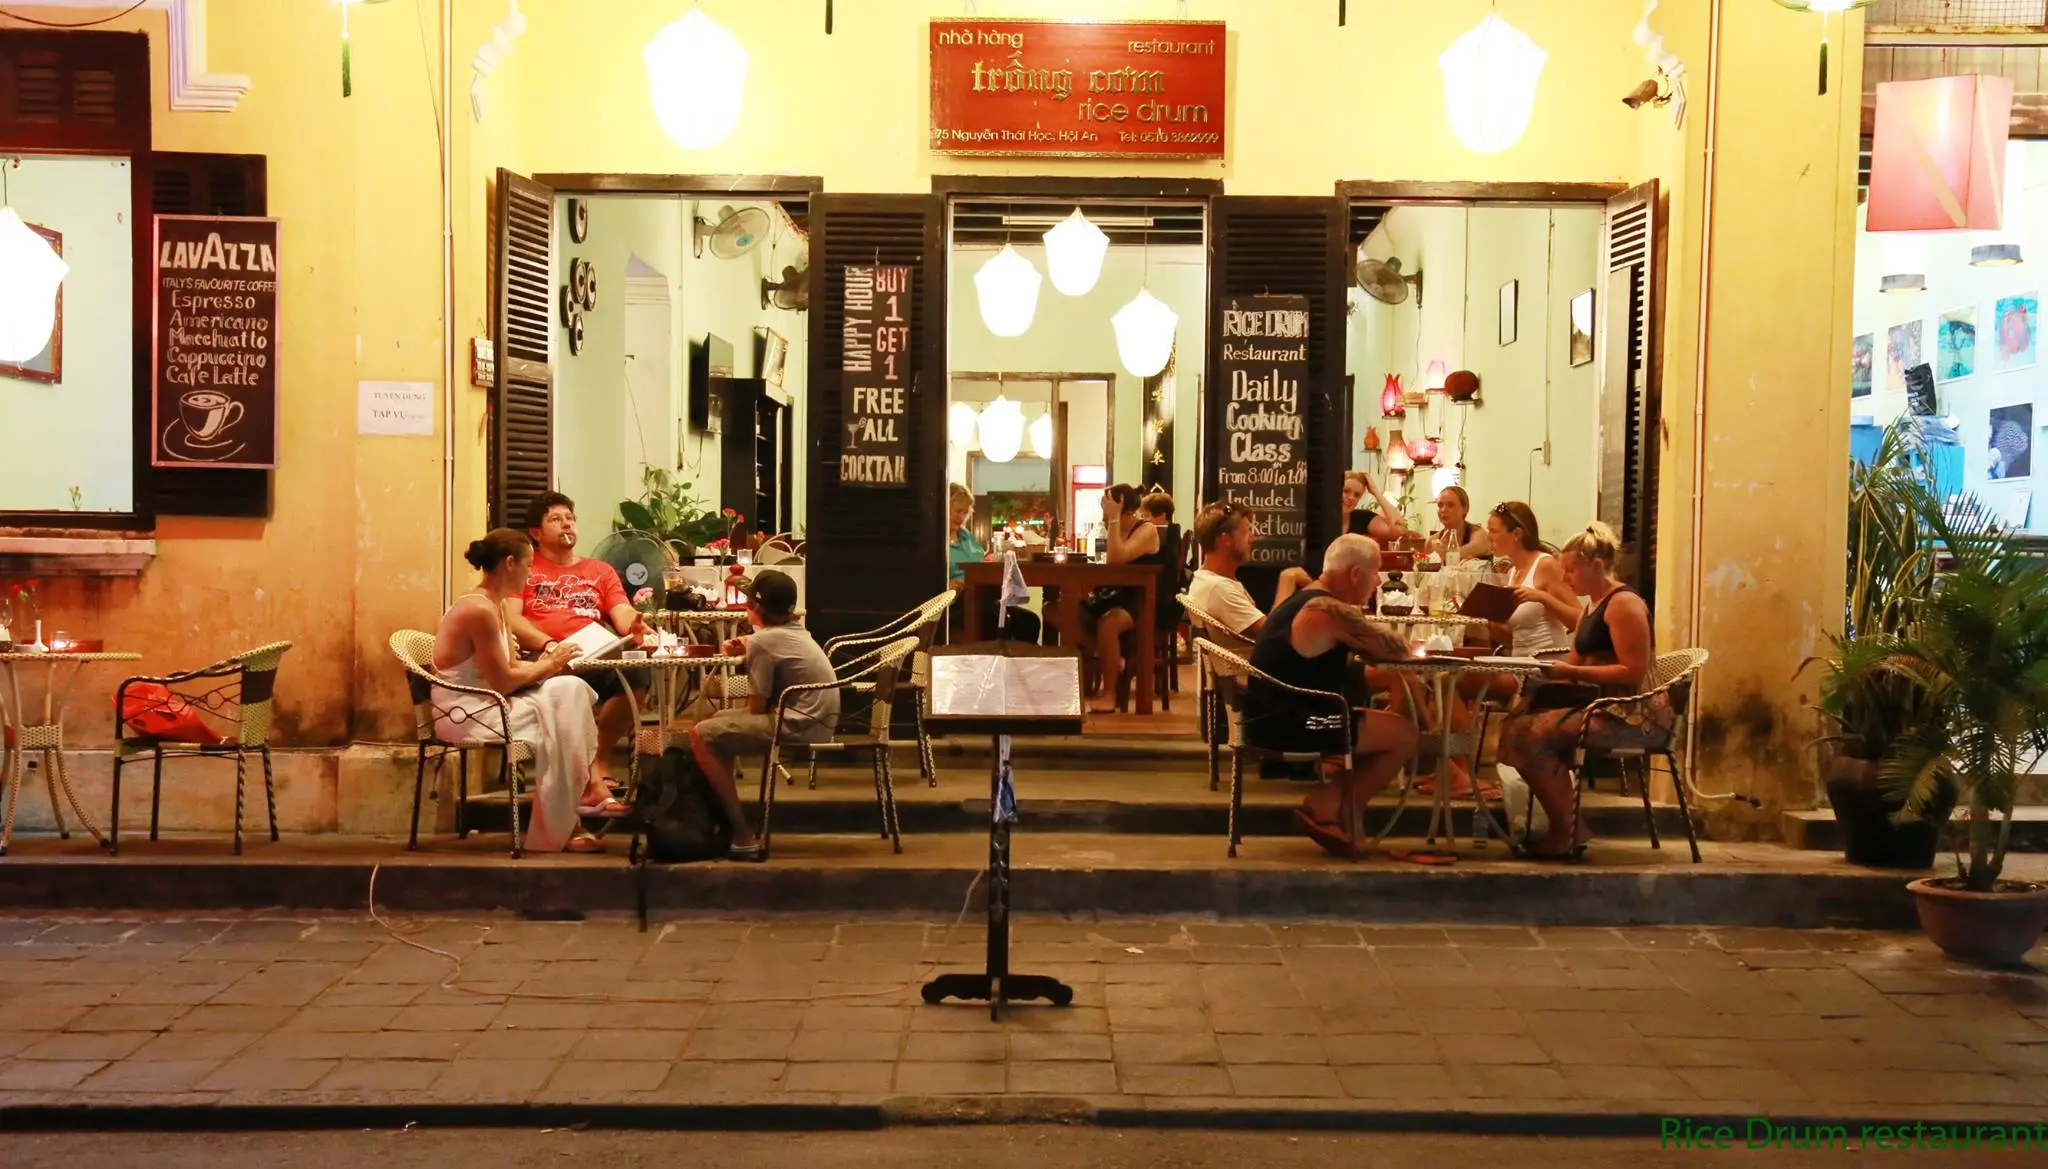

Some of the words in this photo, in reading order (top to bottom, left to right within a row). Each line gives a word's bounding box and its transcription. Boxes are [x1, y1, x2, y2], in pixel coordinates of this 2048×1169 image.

[939, 29, 974, 45] nhà
[977, 29, 1024, 48] hàng
[1127, 38, 1215, 55] restaurant
[1088, 65, 1164, 94] cơm
[1078, 97, 1129, 123] rice
[1136, 98, 1209, 123] drum
[936, 128, 949, 140] 75
[951, 128, 999, 142] Nguyễn
[1080, 131, 1099, 142] An
[160, 232, 275, 272] LAVAZZA
[163, 277, 193, 289] ITALY'S
[194, 278, 246, 291] FAVOURITE
[844, 265, 874, 311] HOUR
[876, 267, 909, 293] BUY
[171, 289, 256, 315] Espresso
[884, 295, 905, 322] 1
[169, 309, 269, 331] Americano
[1223, 309, 1265, 338] RICE
[1264, 309, 1310, 339] DRUM
[843, 317, 873, 372] HAPPY
[876, 327, 909, 352] GET
[1223, 343, 1308, 361] Restaurant
[166, 347, 267, 370] Cappuccino
[884, 354, 898, 380] 1
[213, 365, 260, 386] Latte
[853, 387, 905, 414] FREE
[1231, 368, 1298, 415] Daily
[862, 418, 899, 442] ALL
[1225, 401, 1302, 440] Cooking
[1230, 431, 1292, 463] Class
[840, 454, 906, 483] COCKTAIL
[1219, 467, 1247, 485] From
[1273, 468, 1286, 486] to
[1225, 487, 1296, 508] Included
